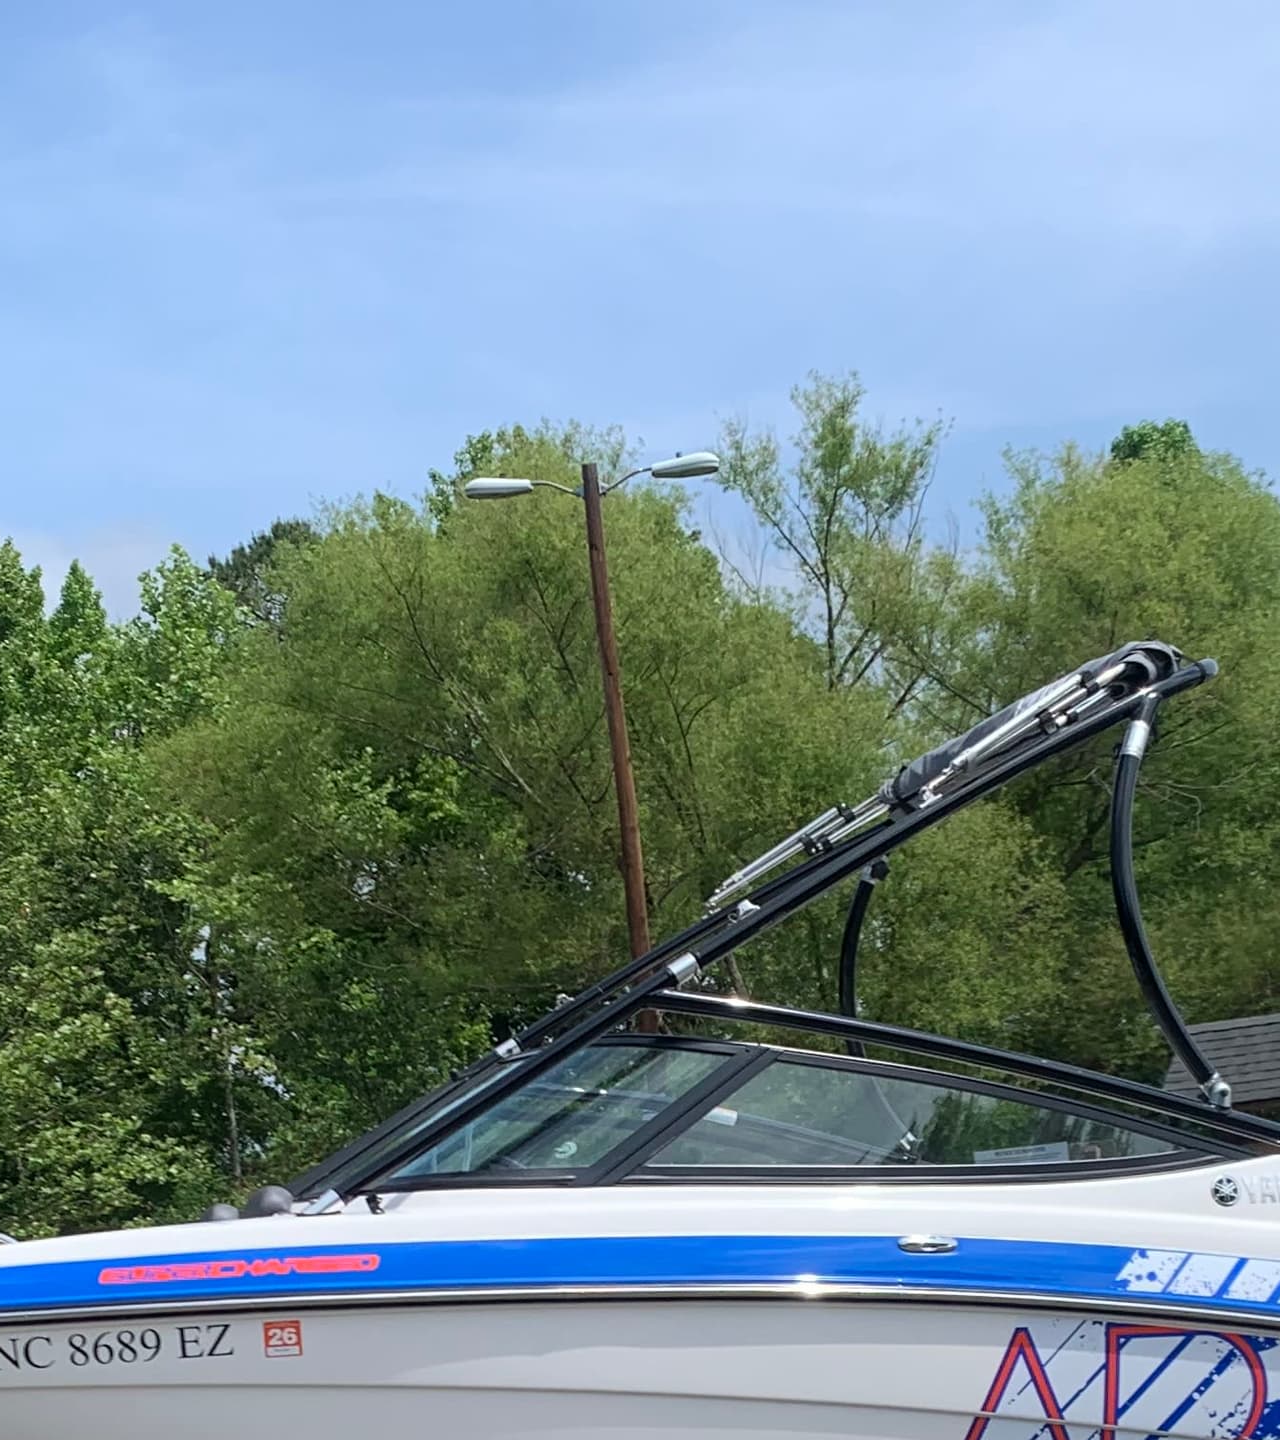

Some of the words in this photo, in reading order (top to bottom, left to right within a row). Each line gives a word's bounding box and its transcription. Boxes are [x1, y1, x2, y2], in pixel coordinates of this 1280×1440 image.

[68, 1328, 161, 1367] 8689
[176, 1323, 235, 1360] EZ
[267, 1328, 298, 1346] 26
